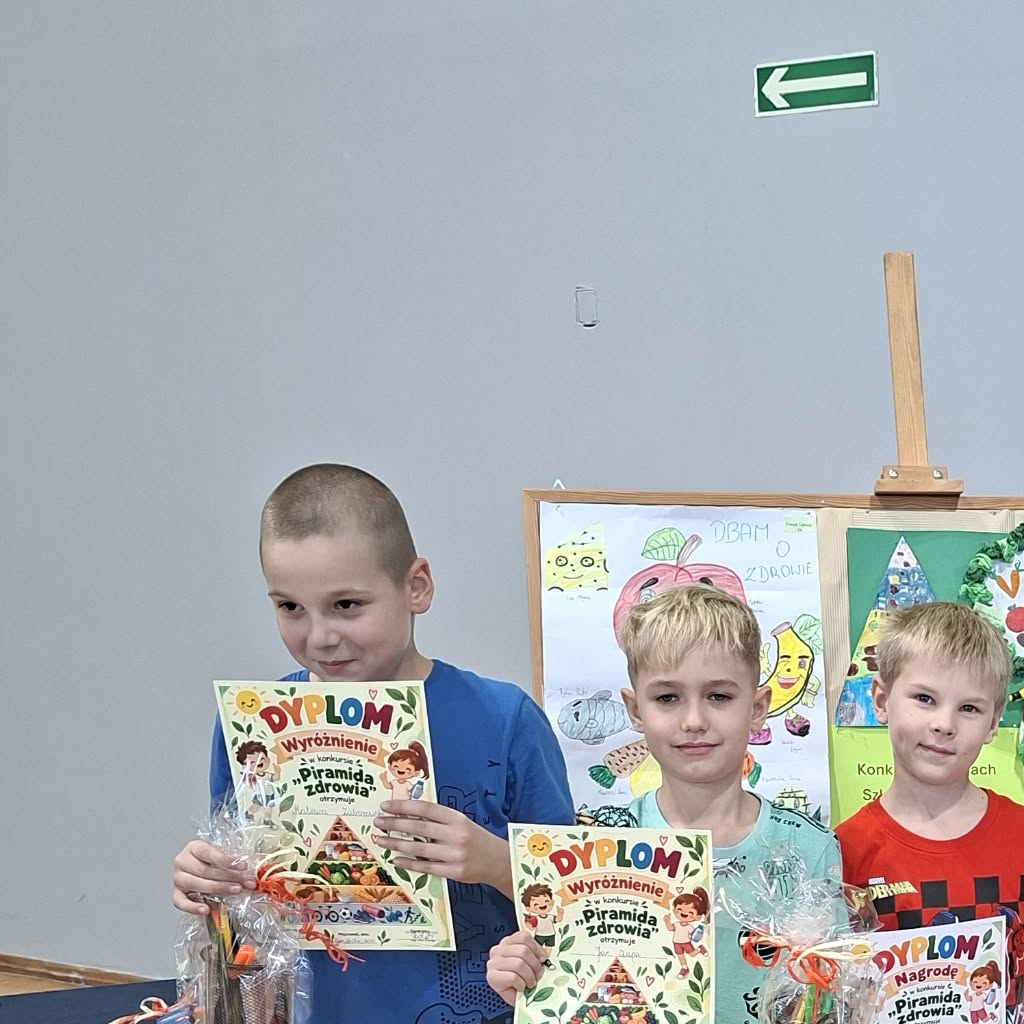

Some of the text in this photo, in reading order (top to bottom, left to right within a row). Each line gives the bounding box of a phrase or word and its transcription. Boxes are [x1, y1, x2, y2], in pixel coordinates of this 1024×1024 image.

[710, 520, 769, 544] DBAM
[776, 540, 791, 558] O
[259, 694, 394, 735] DYPLOM
[280, 731, 378, 756] Wyróżnienie
[309, 753, 354, 766] w konkursie
[857, 763, 996, 776] Konk ach
[292, 766, 374, 786] „Piramida
[303, 778, 377, 799] zdrowia”
[319, 795, 356, 805] otrzymuje
[549, 838, 682, 879] DYPLOM
[567, 874, 664, 898] Wyróżnienie
[602, 895, 640, 907] konkursie
[574, 908, 658, 927] „Piramida
[586, 921, 660, 940] zdrowia”
[600, 936, 636, 946] otrzymuje
[872, 934, 980, 975] DYPLOM
[894, 964, 959, 988] Nagrodę
[916, 983, 946, 994] konkursie
[887, 991, 962, 1019] „Piramida
